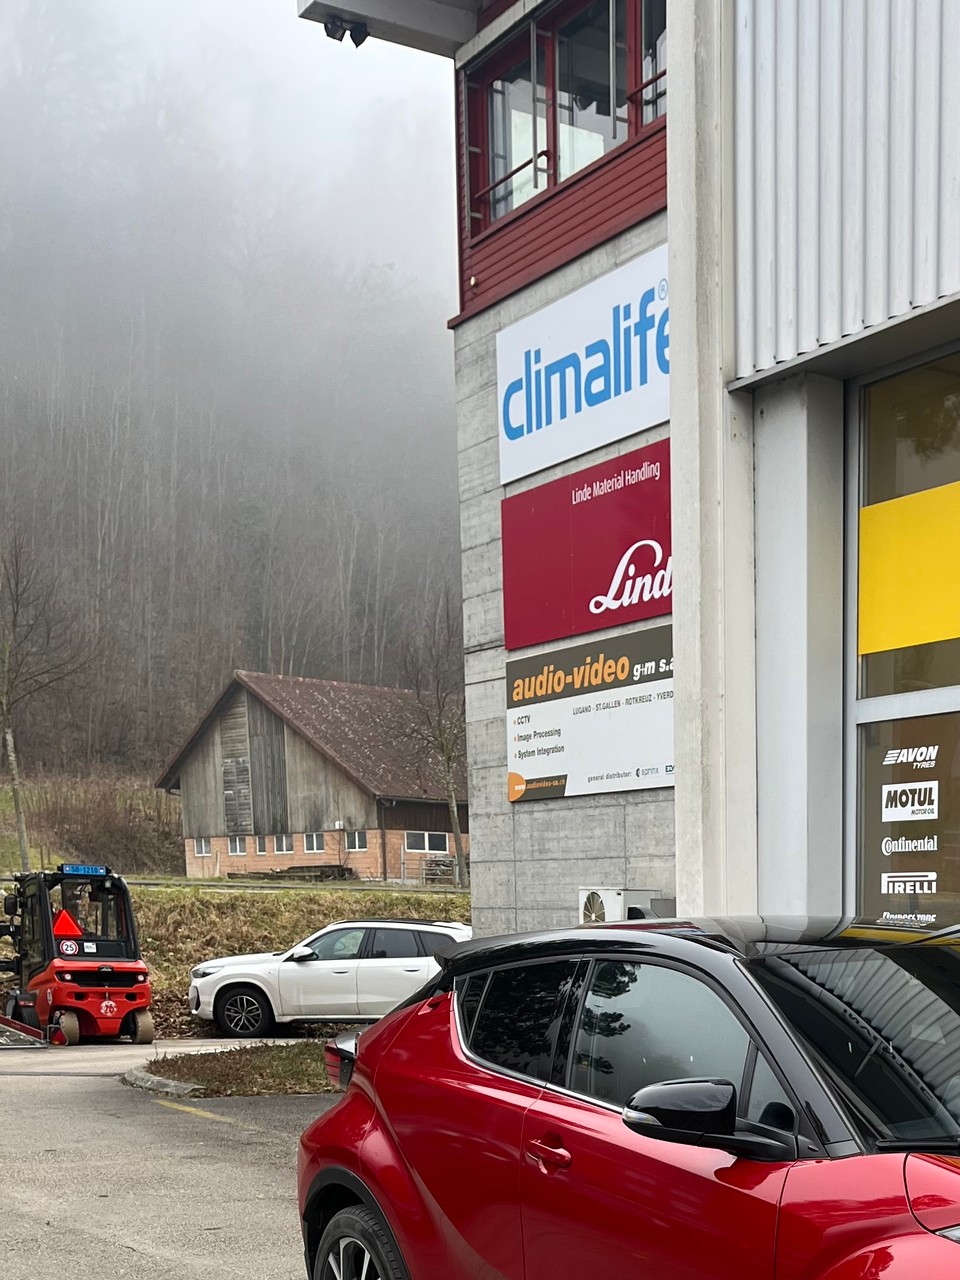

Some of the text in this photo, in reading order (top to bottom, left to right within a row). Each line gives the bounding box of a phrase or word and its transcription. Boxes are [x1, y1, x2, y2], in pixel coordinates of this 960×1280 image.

[572, 461, 660, 505] Linde Material Handling
[512, 653, 630, 702] audio-video
[572, 705, 592, 715] LUGANO
[517, 715, 530, 725] CCTV
[517, 728, 561, 742] Image Processing
[518, 745, 564, 760] System Integration
[896, 745, 939, 763] AVON
[912, 760, 936, 769] TYRES
[885, 787, 935, 809] MOTUL
[881, 835, 938, 856] Continental
[881, 871, 937, 894] PIRELLI
[64, 944, 75, 952] 25
